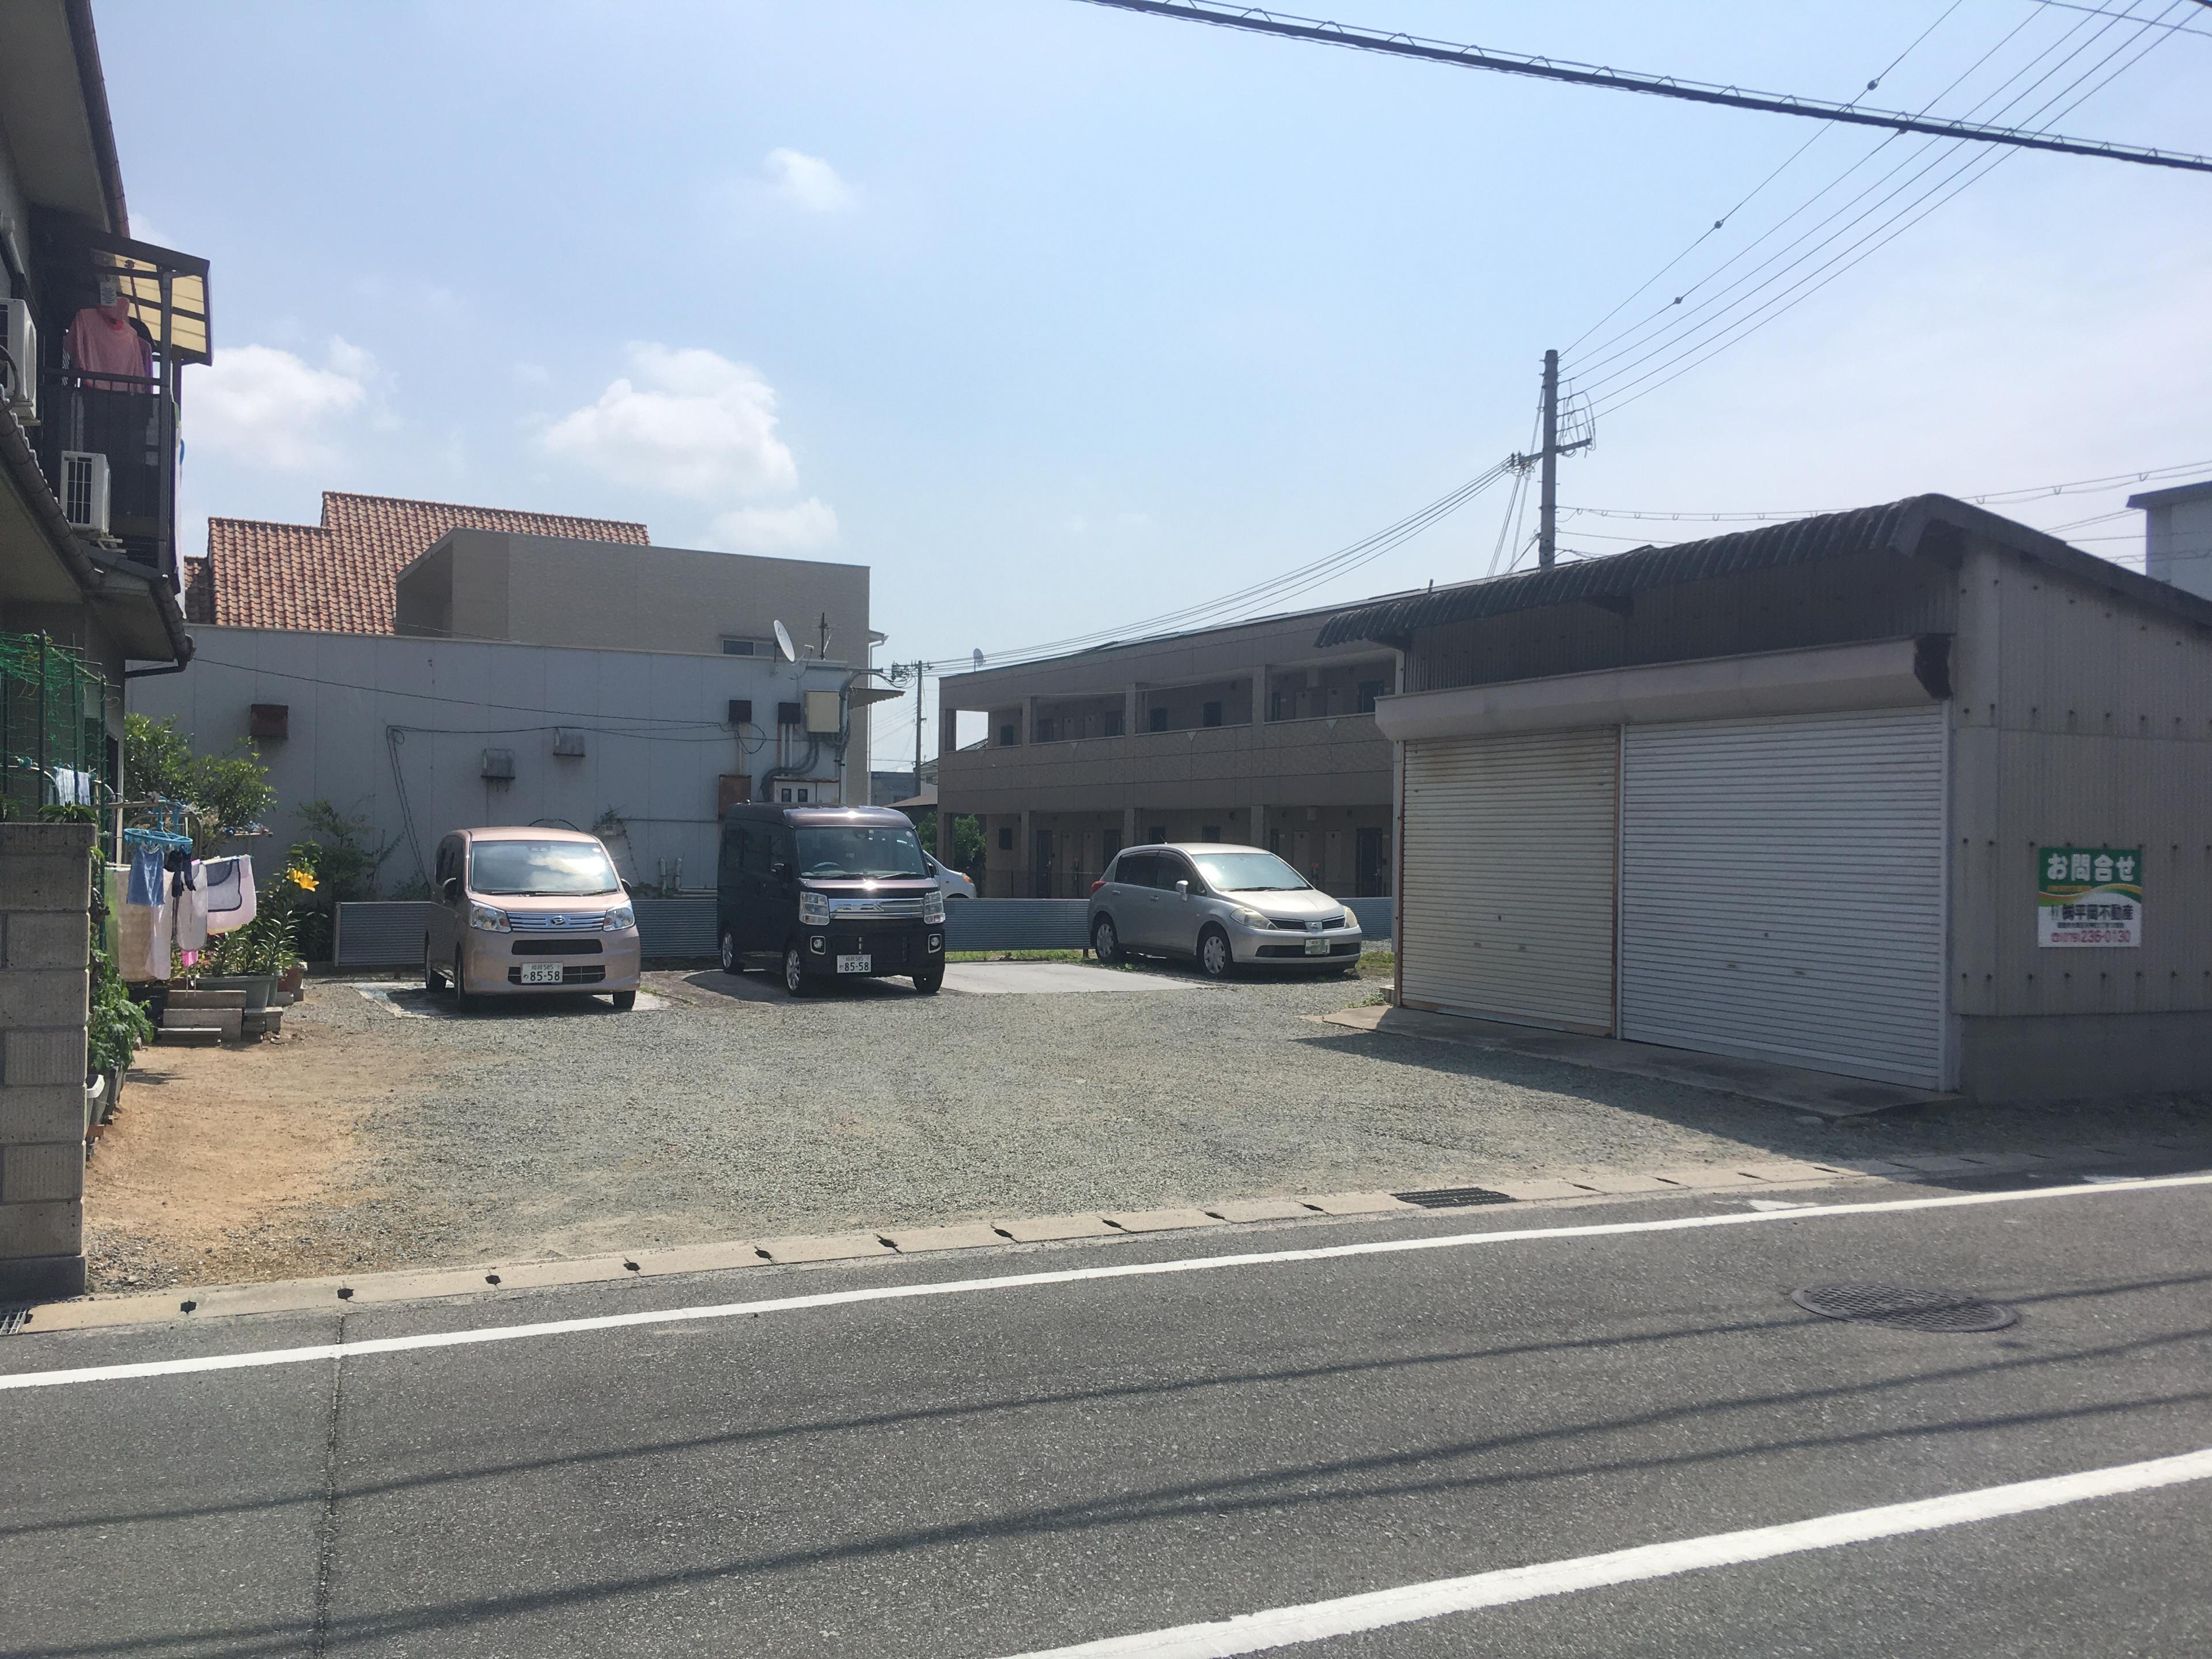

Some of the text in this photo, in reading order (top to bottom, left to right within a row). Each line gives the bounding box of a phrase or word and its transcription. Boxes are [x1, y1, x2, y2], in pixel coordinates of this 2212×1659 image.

[2047, 853, 2135, 881] お問合せ
[844, 962, 869, 971] 85-58
[530, 971, 560, 981] 85-58
